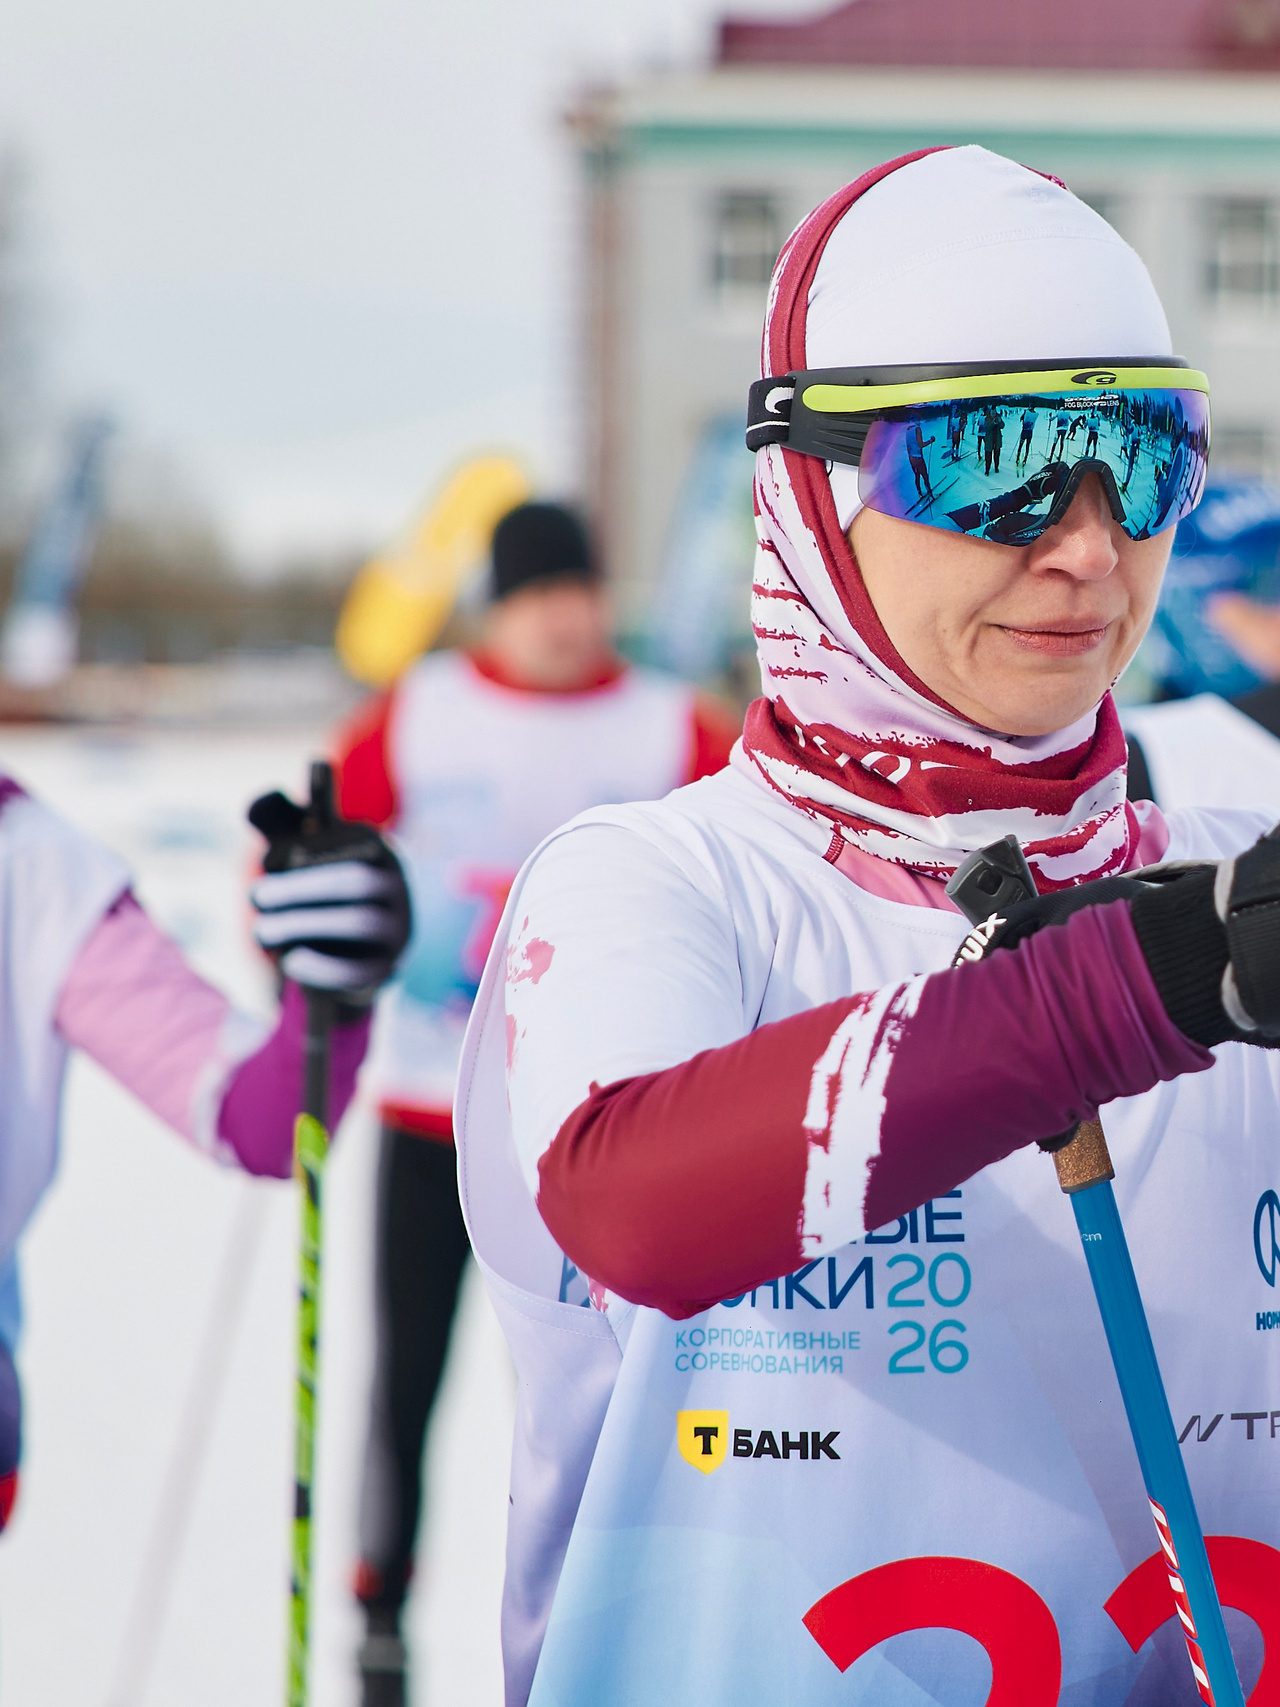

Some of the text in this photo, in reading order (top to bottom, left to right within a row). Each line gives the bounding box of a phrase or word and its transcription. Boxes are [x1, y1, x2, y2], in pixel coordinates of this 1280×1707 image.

[886, 1252, 972, 1308] 20
[675, 1328, 861, 1350] КОРПОРАТИВНЫЕ
[887, 1319, 970, 1374] 26
[675, 1352, 844, 1374] СОРЕВНОВАНИЯ
[732, 1428, 841, 1460] БАНК
